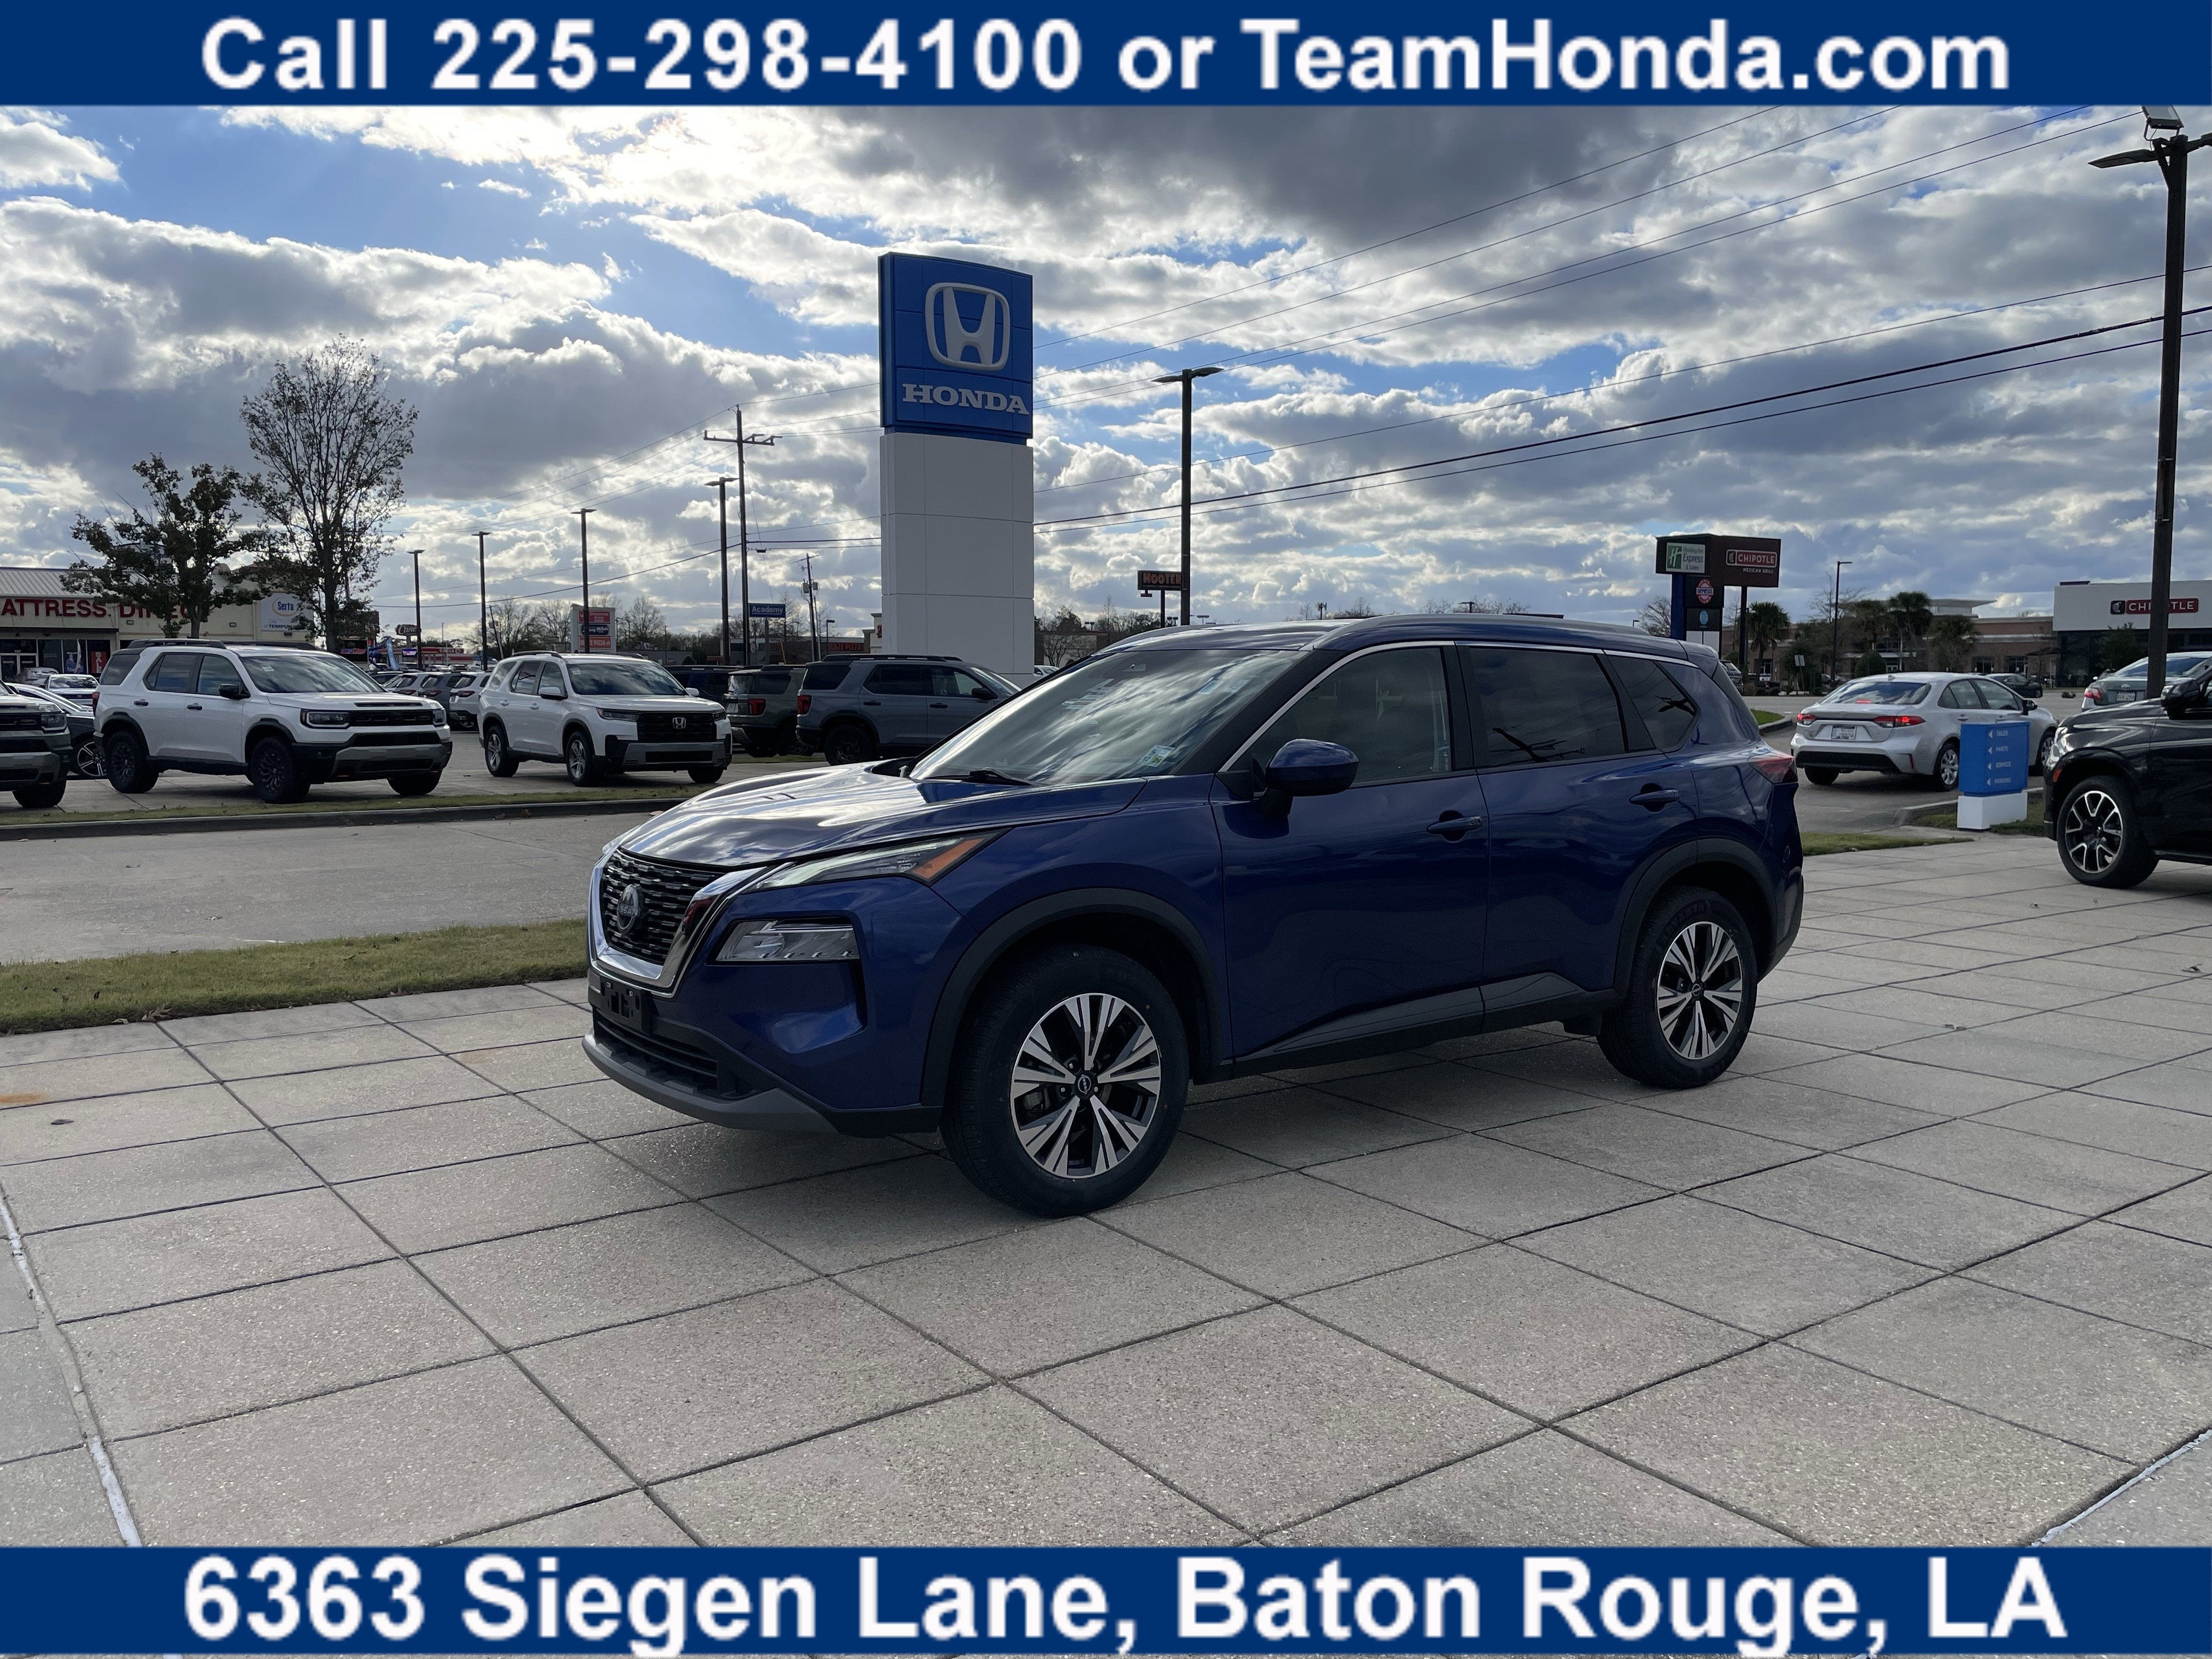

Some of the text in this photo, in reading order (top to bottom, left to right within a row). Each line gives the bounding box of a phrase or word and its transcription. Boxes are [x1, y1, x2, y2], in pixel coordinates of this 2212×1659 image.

[902, 383, 1029, 415] HONDA
[1683, 553, 1703, 563] Express
[1738, 554, 1775, 564] CHIPOTLE
[1143, 573, 1182, 585] HOOTER
[1, 599, 107, 618] ATTRESS
[278, 601, 294, 611] Serta
[752, 606, 783, 614] Academy
[2129, 601, 2194, 611] CHITLE
